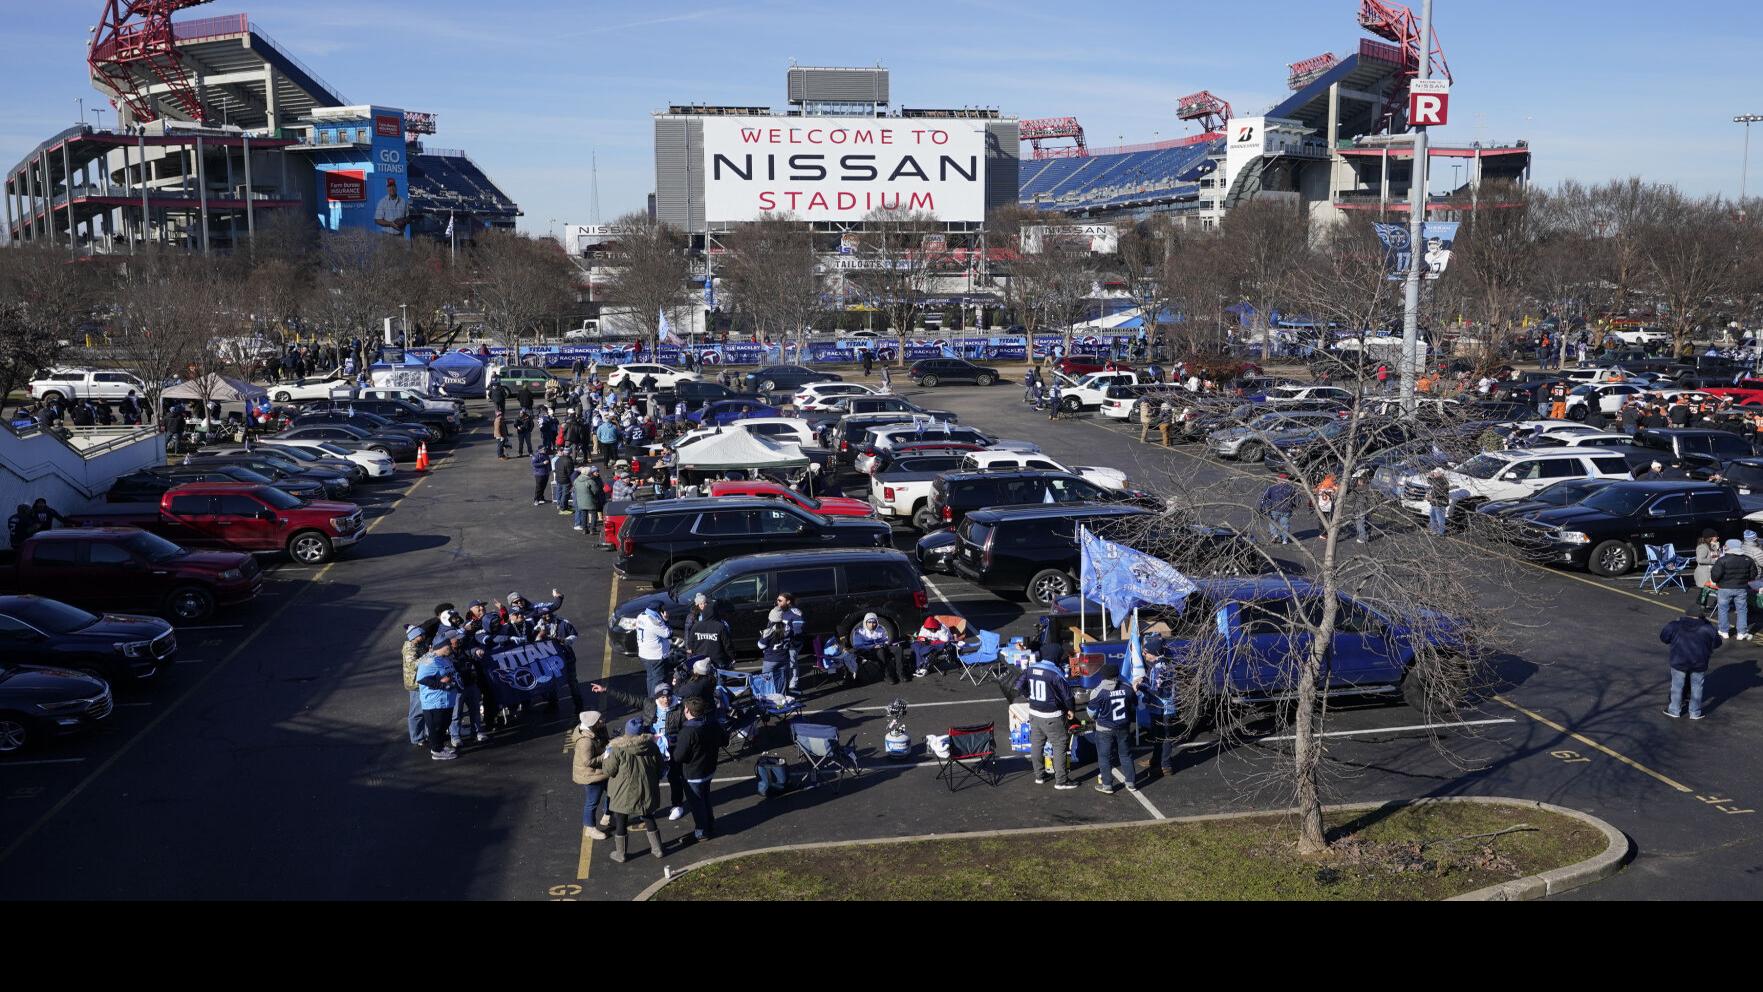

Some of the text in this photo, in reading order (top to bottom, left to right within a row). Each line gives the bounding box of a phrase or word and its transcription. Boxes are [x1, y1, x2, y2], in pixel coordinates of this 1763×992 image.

[1415, 95, 1441, 123] R
[741, 129, 949, 145] WELCOME TO
[380, 149, 400, 163] GO
[713, 153, 977, 182] NISSAN
[759, 191, 935, 211] STADIUM
[1044, 226, 1108, 234] NISSAN
[694, 632, 718, 641] TITANS
[490, 640, 558, 671] TITAN
[529, 655, 565, 683] UP
[1029, 678, 1047, 702] 10
[1110, 697, 1126, 721] 2
